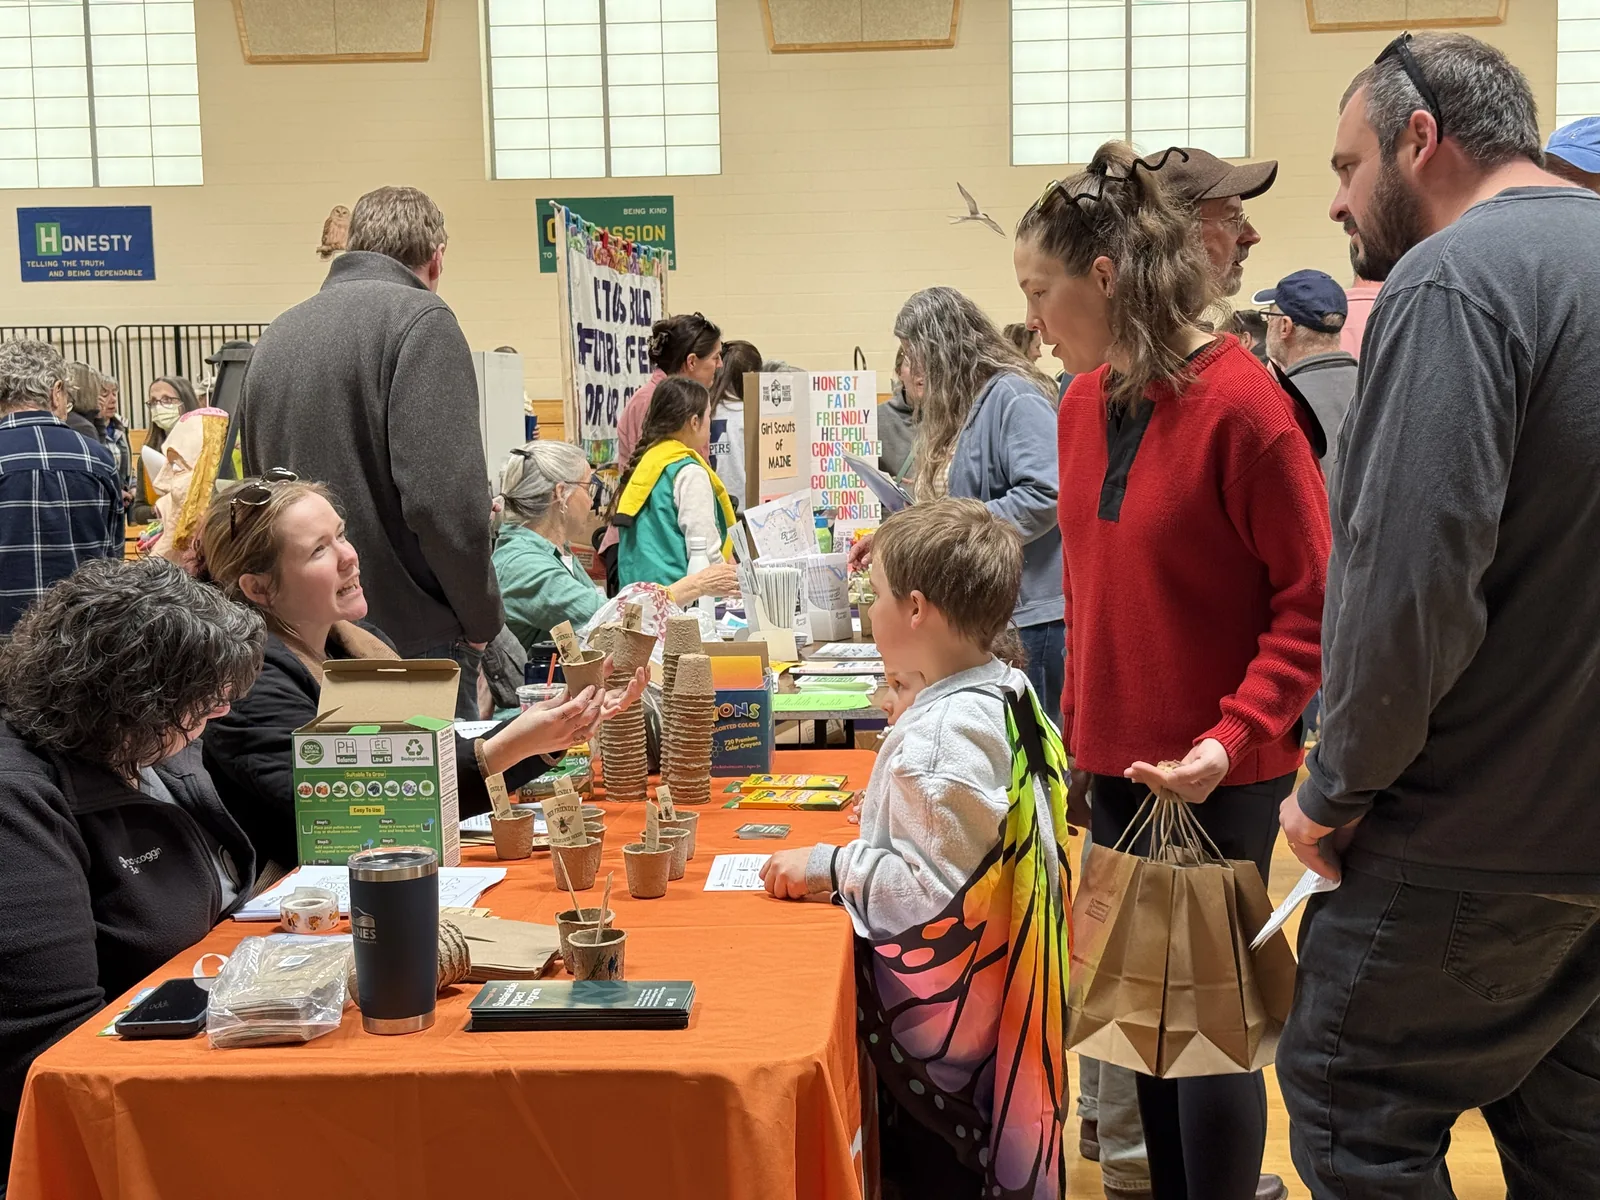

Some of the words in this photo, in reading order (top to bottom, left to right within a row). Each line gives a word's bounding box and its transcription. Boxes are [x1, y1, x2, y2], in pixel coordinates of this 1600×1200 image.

[40, 227, 132, 252] HONESTY
[813, 376, 858, 391] HONEST
[827, 393, 855, 409] FAIR
[816, 409, 870, 426] FRIENDLY
[761, 422, 773, 435] Girl
[774, 421, 795, 434] Scouts
[821, 427, 868, 441] HELPFUL
[775, 438, 783, 451] of
[768, 454, 792, 469] MAINE
[821, 490, 864, 505] STRONG
[337, 741, 355, 753] PH
[374, 740, 387, 750] EC
